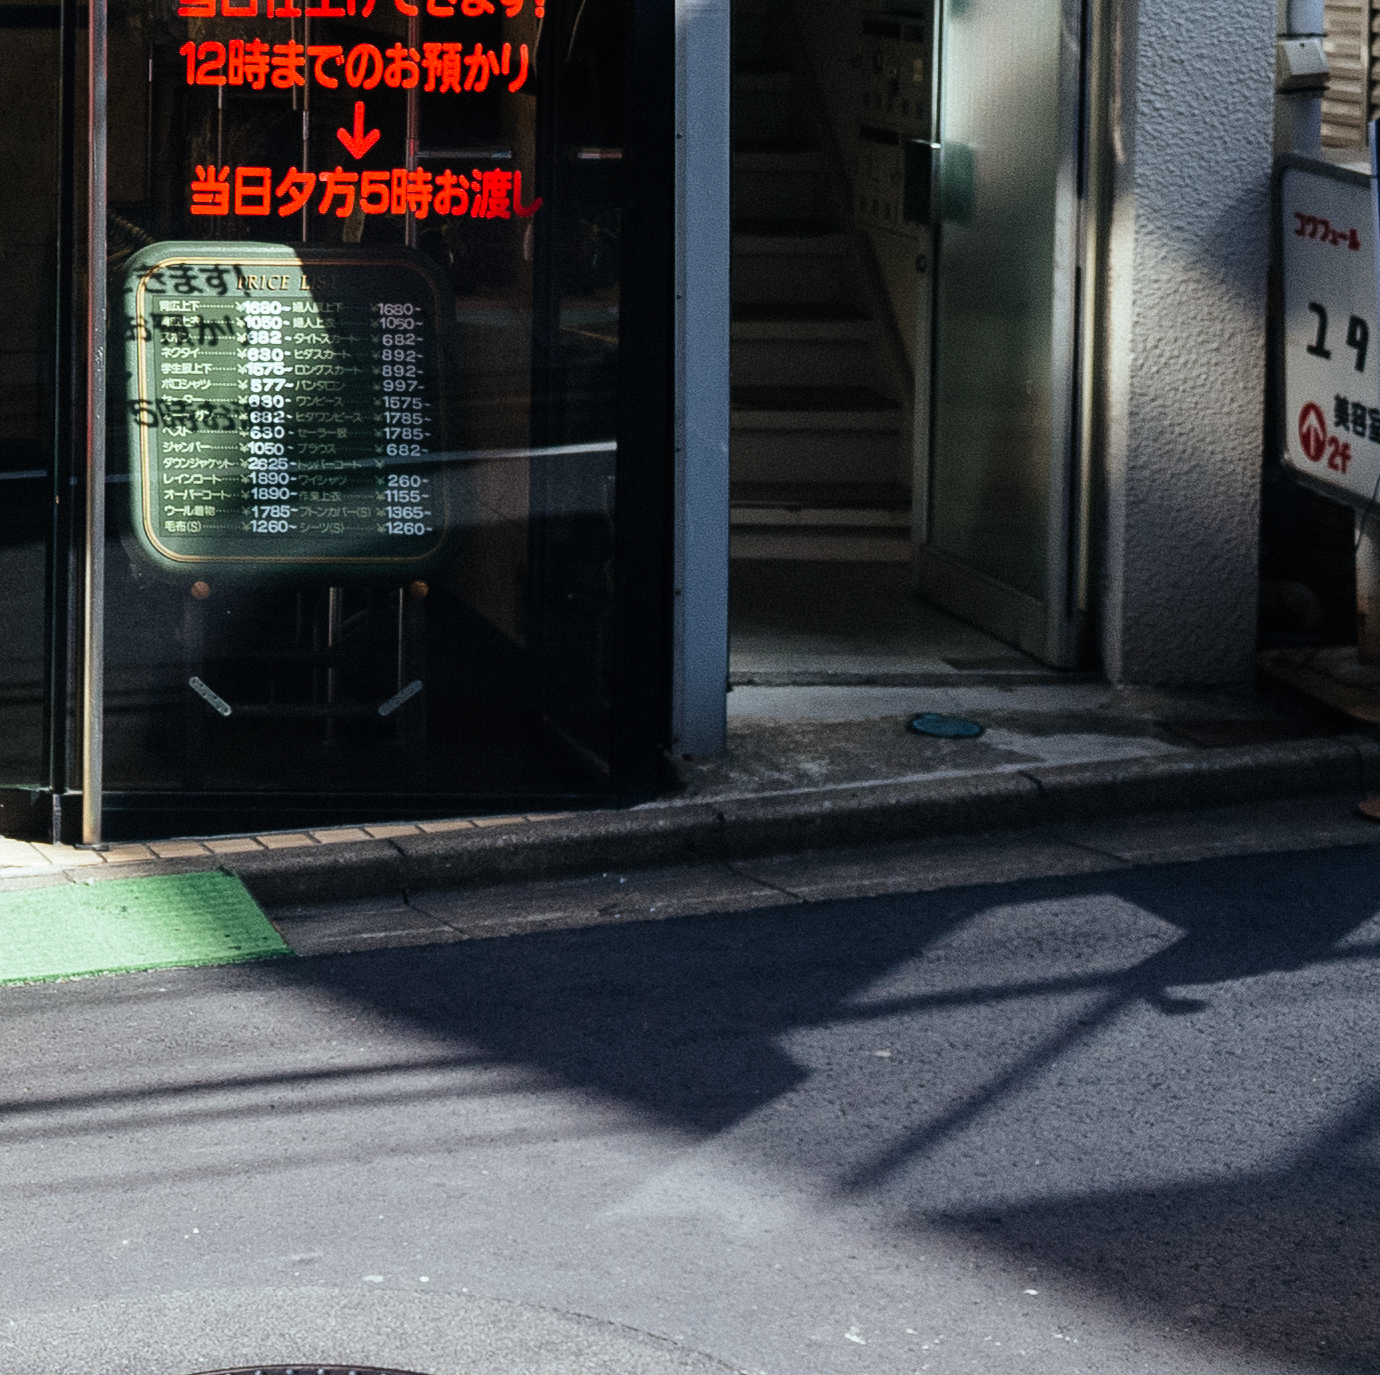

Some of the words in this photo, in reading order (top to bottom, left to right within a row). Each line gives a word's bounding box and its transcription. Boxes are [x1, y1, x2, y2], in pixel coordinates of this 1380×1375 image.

[178, 37, 529, 93] 12時までのお預かり
[190, 165, 543, 220] 当日夕方5時お渡し
[236, 275, 290, 291] PRICE
[300, 274, 339, 291] LIST
[161, 347, 200, 359] ネクタイ
[163, 473, 222, 485] レインコート
[163, 489, 231, 500] オーバーコート
